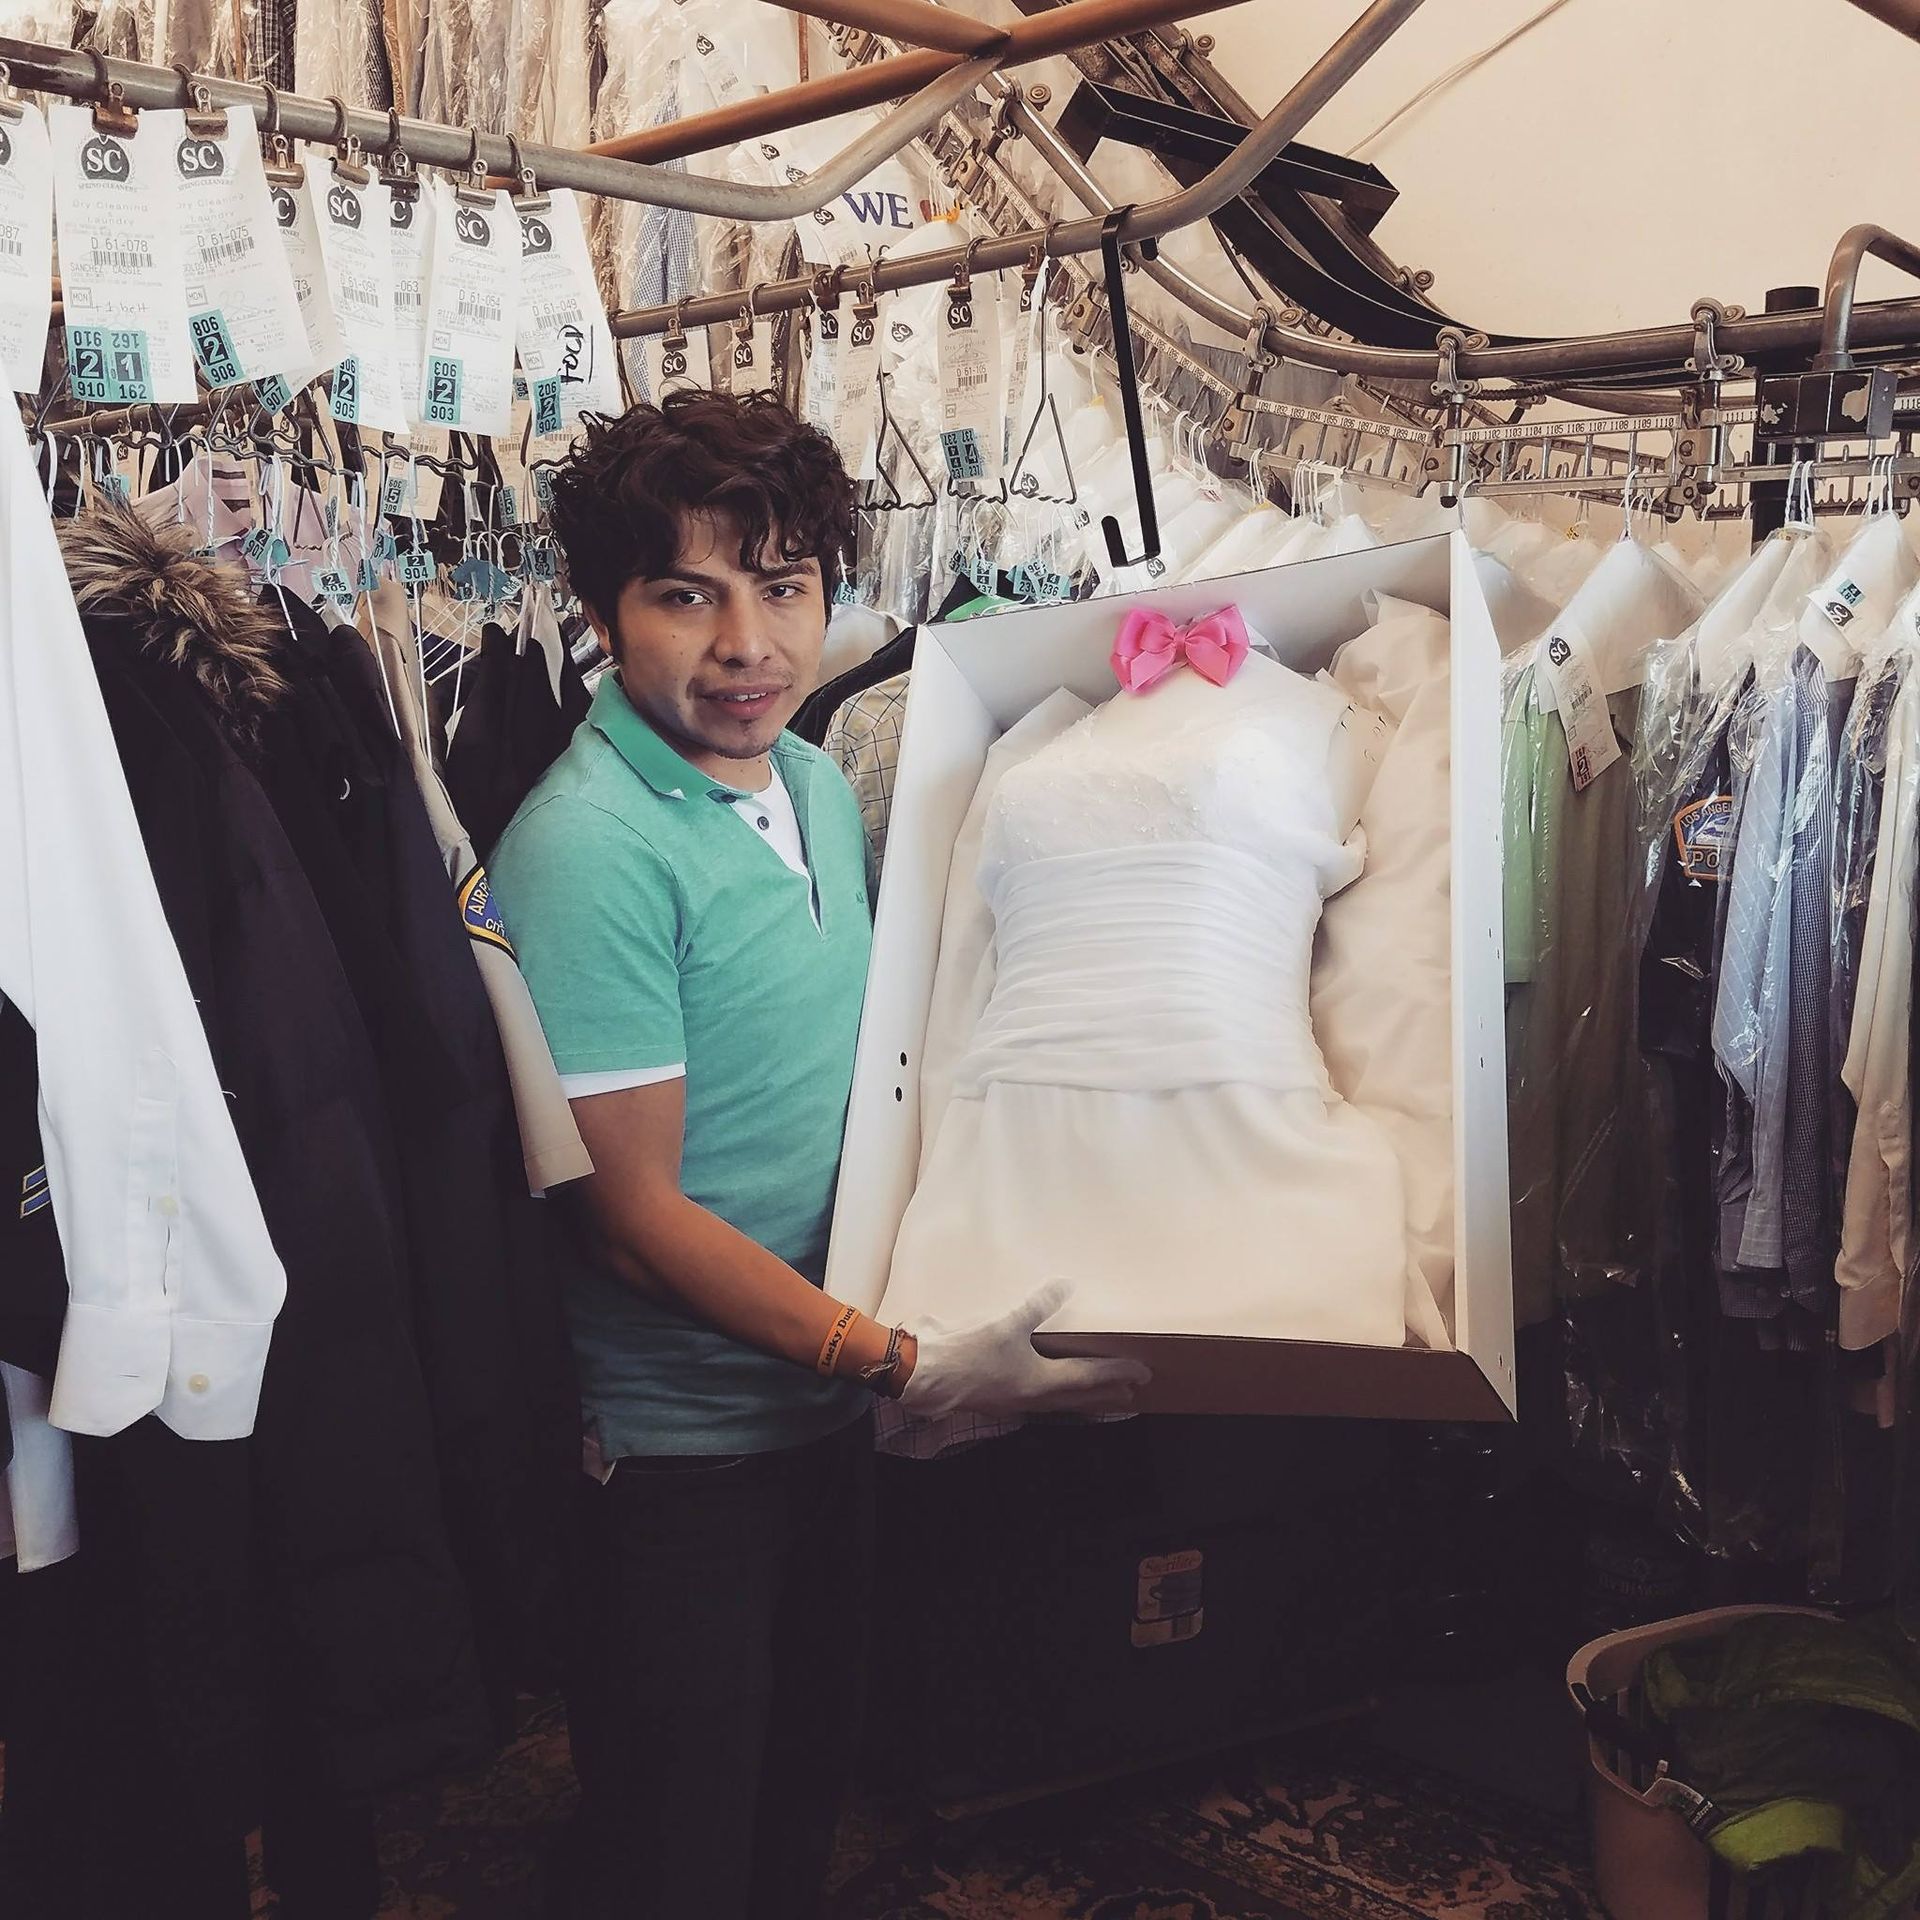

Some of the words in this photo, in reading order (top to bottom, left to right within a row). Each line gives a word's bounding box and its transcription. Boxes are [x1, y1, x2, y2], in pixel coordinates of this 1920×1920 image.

[86, 147, 122, 174] SC
[181, 145, 218, 172] SC
[329, 195, 357, 221] SC
[841, 191, 914, 229] WE
[457, 217, 485, 240] SC
[950, 305, 969, 324] SC
[853, 325, 872, 342] SC
[203, 337, 225, 365] 2
[735, 347, 752, 364] SC
[80, 350, 100, 378] 2
[120, 353, 136, 380] 1
[210, 363, 236, 383] 908
[663, 355, 684, 373] SC
[77, 381, 105, 398] 910
[119, 383, 147, 400] 162
[340, 373, 354, 400] 2
[436, 379, 453, 403] 2
[334, 400, 355, 419] 905
[431, 405, 454, 421] 903
[542, 398, 556, 418] 2
[1726, 412, 1744, 423] 1111
[539, 417, 557, 433] 902
[1464, 431, 1480, 441] 1101
[1484, 429, 1500, 440] 1102
[1505, 427, 1522, 438] 1103
[1525, 426, 1541, 437] 1104
[1546, 424, 1563, 435] 1105
[1567, 422, 1585, 433] 1106
[1589, 421, 1607, 432] 1107
[1610, 420, 1629, 431] 1108
[1633, 418, 1652, 429] 1109
[1655, 417, 1674, 428] 1110
[389, 489, 399, 502] 5
[246, 540, 264, 560] 907
[412, 556, 421, 566] 2
[326, 575, 336, 585] 2
[404, 567, 429, 579] 904
[1042, 583, 1060, 596] 236
[1550, 639, 1568, 663] SC
[1680, 811, 1700, 828] LOS
[821, 1330, 842, 1367] Lucky
